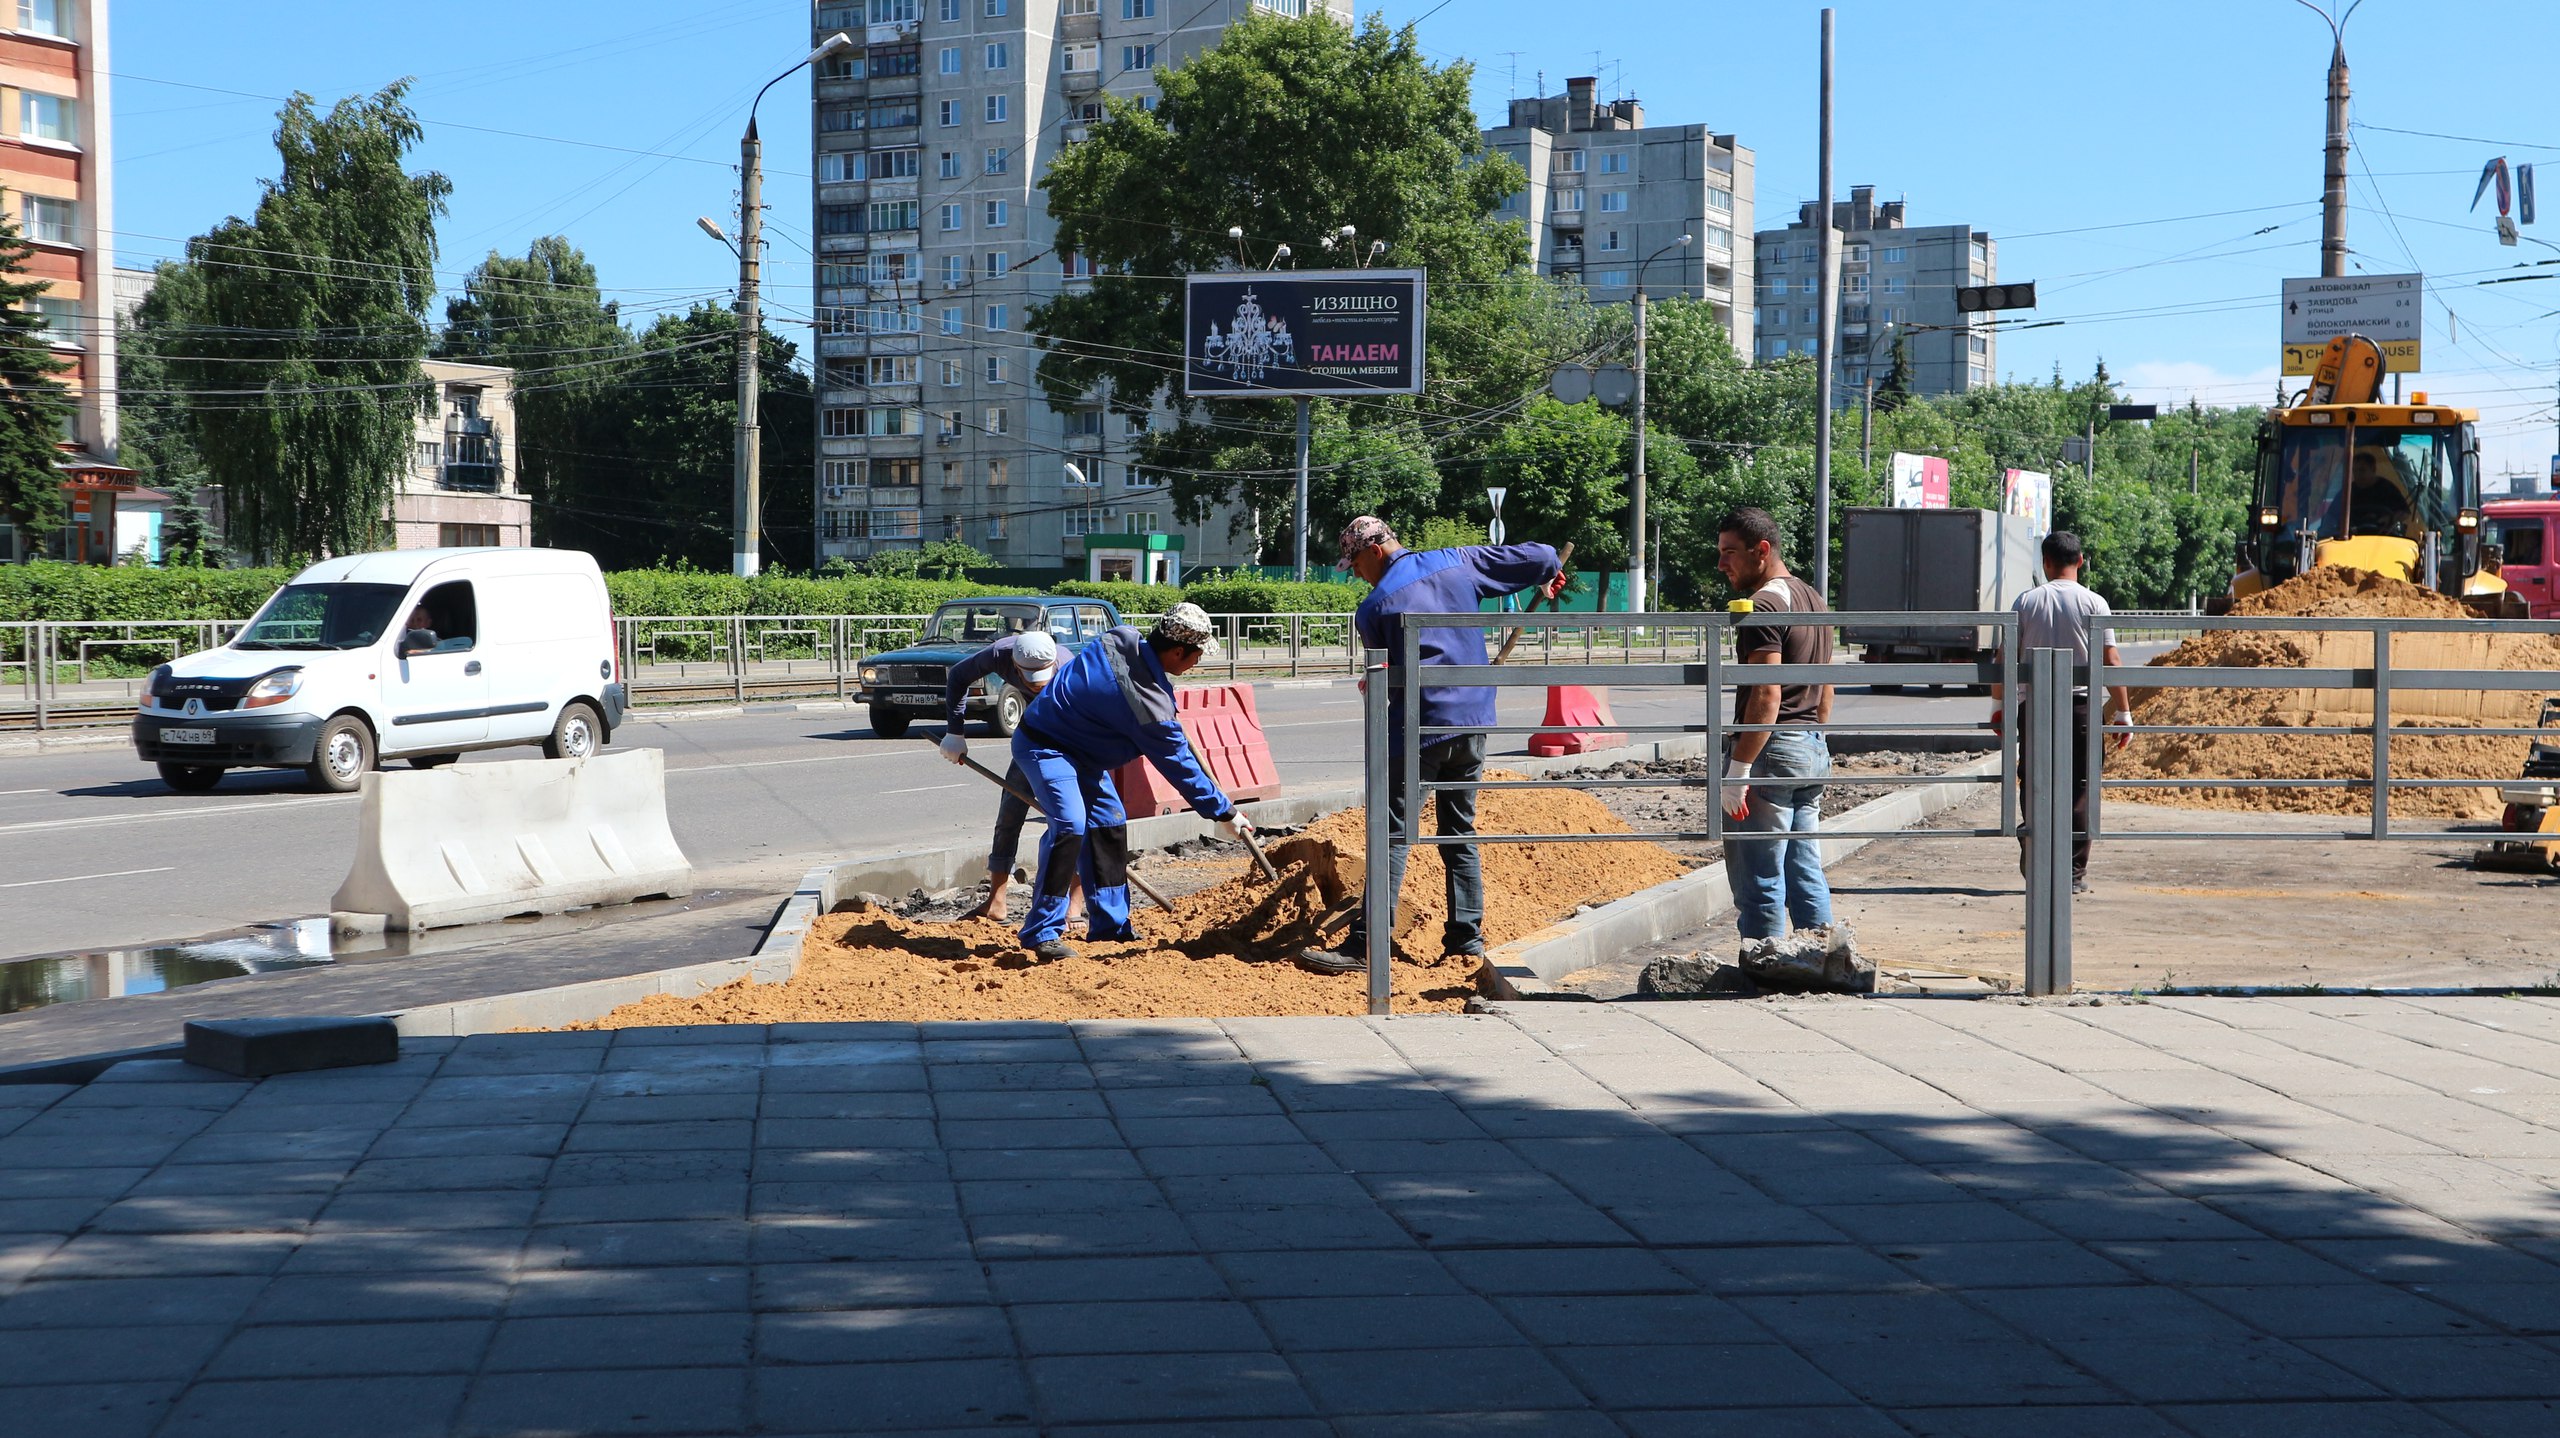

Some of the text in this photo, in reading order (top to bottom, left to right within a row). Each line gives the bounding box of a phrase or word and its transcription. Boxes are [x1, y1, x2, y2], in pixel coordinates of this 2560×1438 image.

[2308, 283, 2371, 292] АВТОВОКЗАЛ
[1313, 296, 1397, 311] ИЗЯЩНО
[2307, 297, 2358, 307] ЗАВИДОВА
[2307, 307, 2335, 316] улица
[2307, 317, 2391, 329] ВОЛОКОЛАМСКИЙ
[2307, 329, 2348, 337] проспект
[1311, 344, 1398, 361] ТАНДЕМ
[1310, 366, 1399, 376] СТОЛИЦА МЕБЕЛИ
